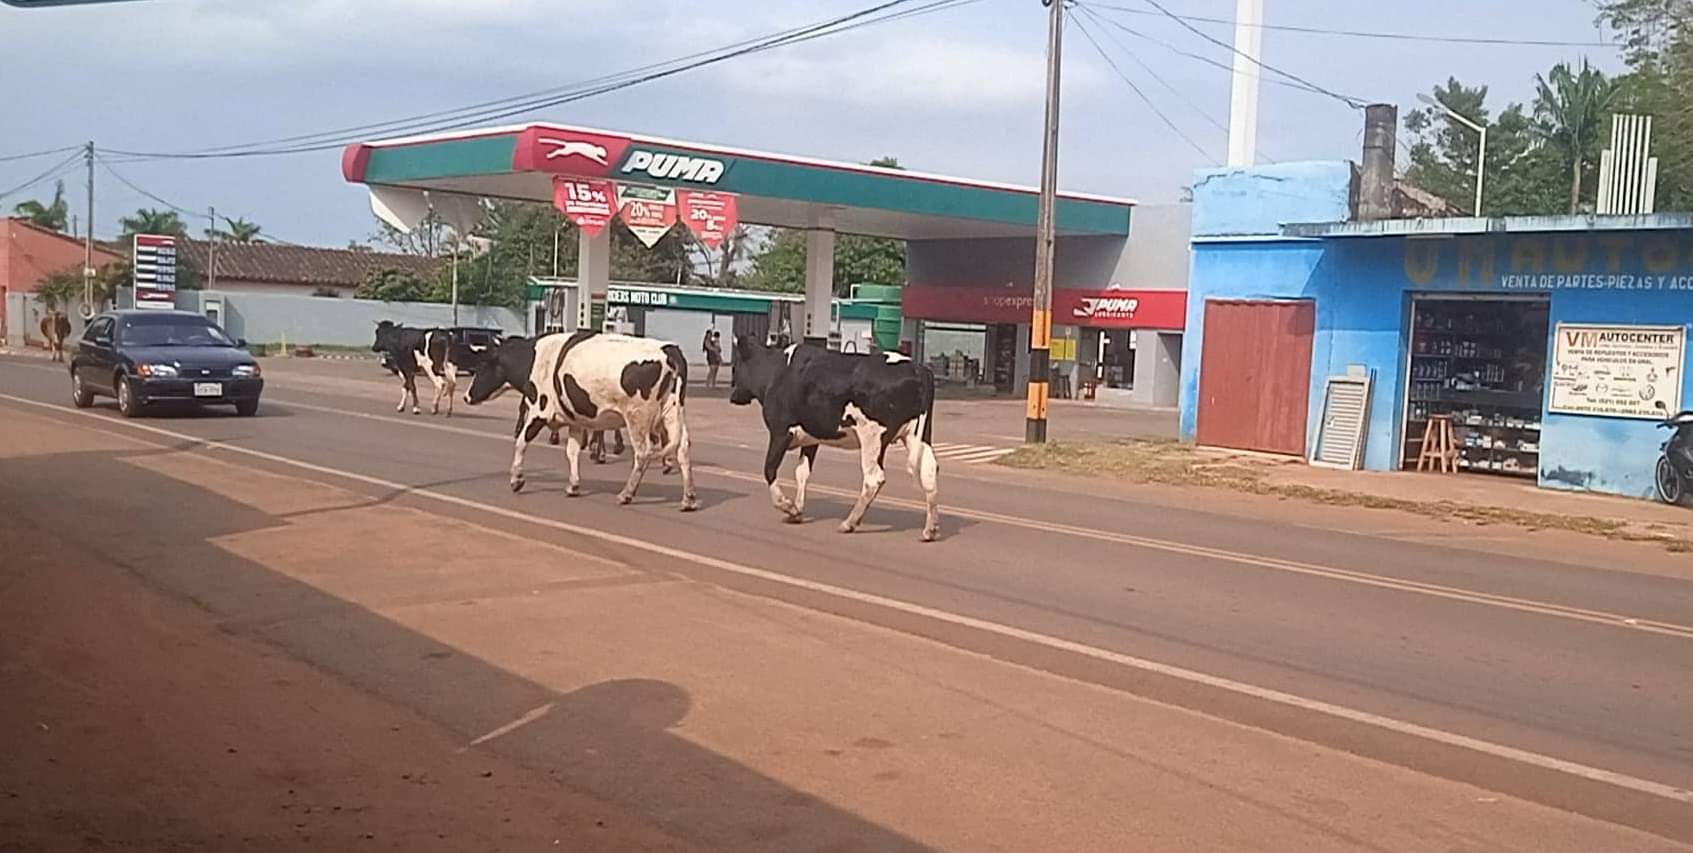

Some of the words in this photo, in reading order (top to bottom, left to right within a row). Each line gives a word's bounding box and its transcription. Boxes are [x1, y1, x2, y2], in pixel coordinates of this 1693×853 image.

[621, 150, 724, 183] PUMA
[565, 182, 606, 202] 15%
[1511, 234, 1693, 272] AUTO
[1501, 274, 1537, 288] VENTA
[1540, 275, 1555, 288] DE
[1657, 276, 1666, 290] Y
[1095, 299, 1138, 312] PUMA
[1566, 331, 1597, 348] VM
[1599, 332, 1674, 344] AUTOCENTER
